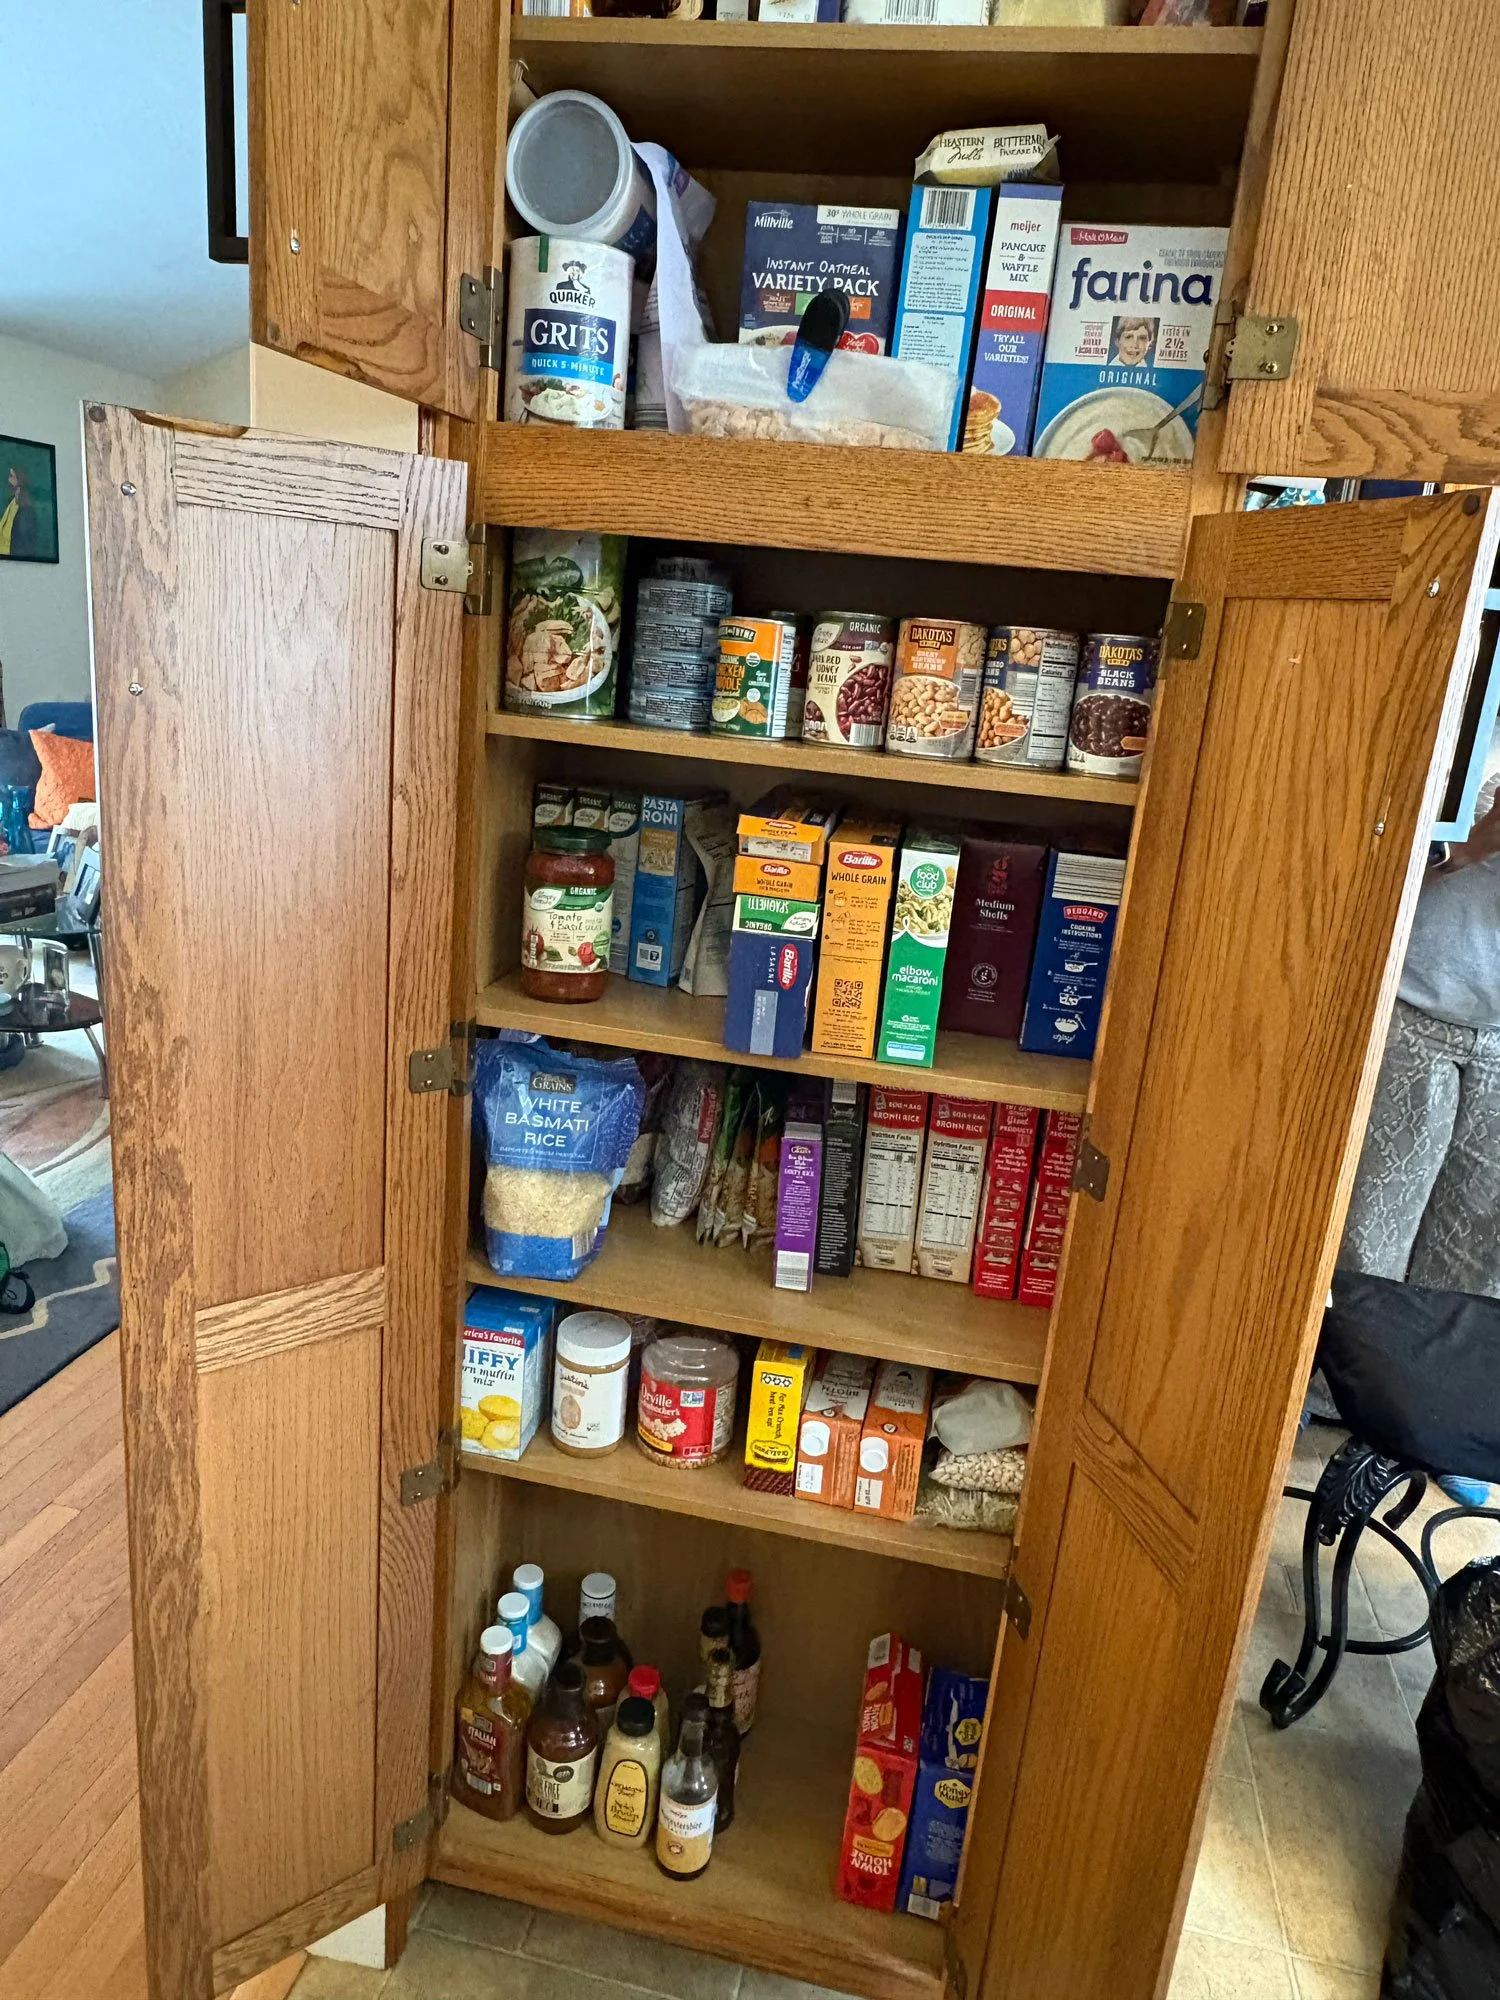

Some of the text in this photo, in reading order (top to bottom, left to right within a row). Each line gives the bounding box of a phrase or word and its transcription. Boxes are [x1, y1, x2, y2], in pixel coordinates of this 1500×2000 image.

[754, 215, 794, 229] Millville
[1010, 220, 1041, 232] meijer
[1001, 242, 1046, 253] PANCAKE
[766, 256, 871, 276] INSTANT OATMEAL
[1001, 262, 1039, 273] WAFFLE
[752, 272, 880, 296] VARIETY PACK
[1009, 272, 1029, 282] MIX
[1069, 257, 1213, 310] farina
[549, 290, 596, 309] QUAKER
[990, 304, 1036, 320] ORIGINAL
[530, 318, 609, 355] GRITS
[993, 333, 1026, 345] TRY ALL
[1164, 337, 1173, 349] 2
[998, 343, 1017, 353] OUR
[531, 357, 605, 376] QUICK 5-MINUTE
[1099, 370, 1157, 387] ORIGINAL
[849, 621, 882, 634] ORGANIC
[1098, 644, 1144, 661] DAKOTA'S
[825, 655, 841, 665] RED
[912, 662, 943, 671] BEANS
[1099, 669, 1135, 680] BLACK
[1097, 676, 1136, 689] BEANS
[642, 795, 679, 813] PASTA
[641, 809, 678, 826] RONI
[841, 854, 881, 867] Barilla
[831, 871, 887, 885] WHOLE GRAIN
[916, 877, 937, 889] club
[569, 886, 598, 896] ORGANIC
[748, 897, 789, 914] SPAGHETTI
[975, 898, 1015, 911] Medium
[546, 911, 583, 922] Tomato
[979, 909, 1008, 921] Shells
[557, 921, 583, 931] Basil
[745, 920, 772, 931] ORGANIC
[767, 946, 776, 983] LASAGNE
[781, 948, 795, 984] Barilla
[899, 964, 933, 977] elbow
[891, 973, 939, 987] macaroni
[532, 1077, 574, 1092] GRAINS
[519, 1096, 582, 1114] WHITE
[505, 1112, 590, 1132] BASMATI
[873, 1110, 920, 1123] BROWN RICE
[936, 1120, 984, 1133] BROWN RICE
[524, 1131, 567, 1148] RICE
[464, 1329, 522, 1346] erica's Favorite
[463, 1366, 514, 1381] rn muffin
[473, 1376, 495, 1386] mix
[641, 1382, 673, 1408] Orville
[822, 1384, 859, 1397] BROTH
[939, 1782, 970, 1799] Honey
[850, 1849, 893, 1868] HOUSE
[850, 1857, 891, 1876] TOWN
